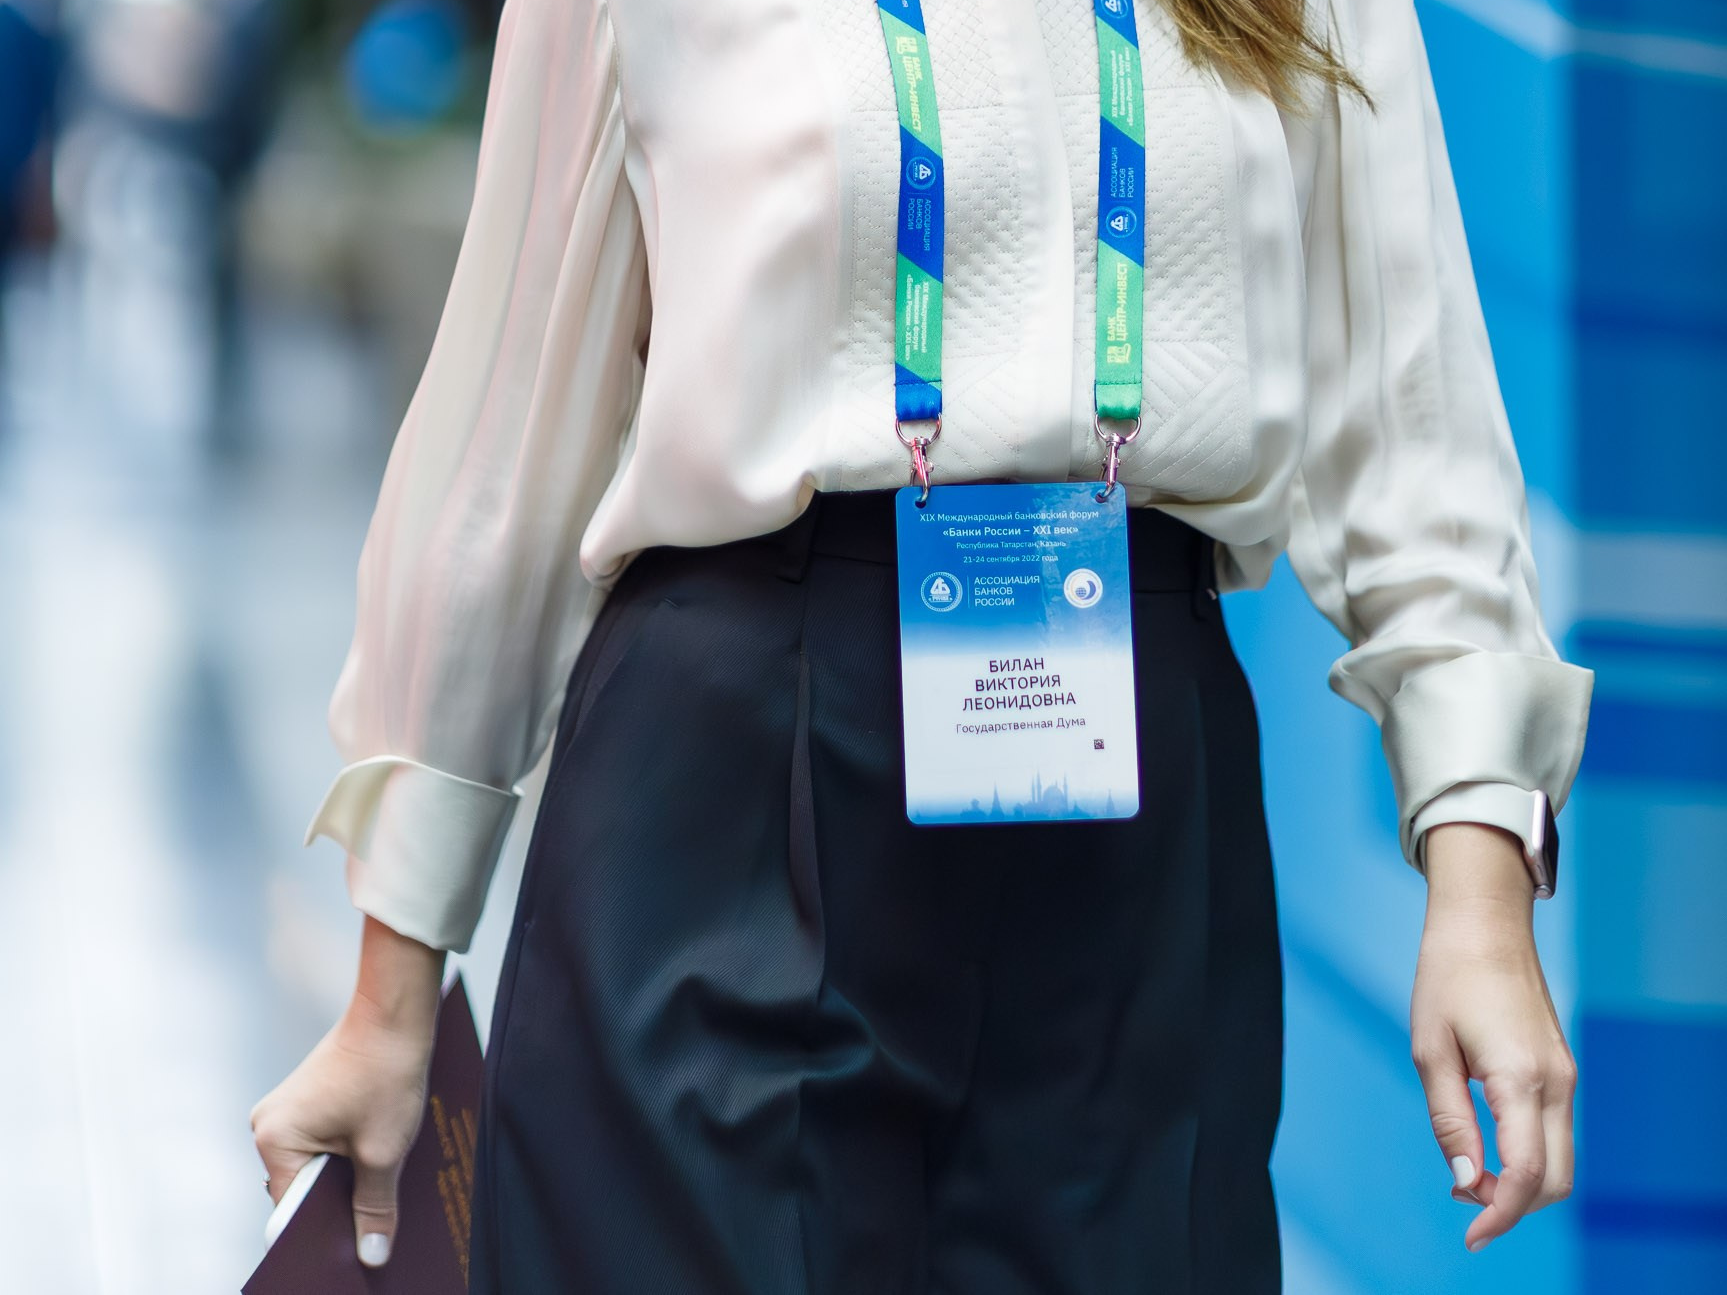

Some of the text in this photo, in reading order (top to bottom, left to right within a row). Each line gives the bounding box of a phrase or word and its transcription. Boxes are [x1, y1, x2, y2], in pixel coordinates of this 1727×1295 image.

[912, 56, 923, 80] БАНК
[902, 56, 922, 132] ЦЕНТР-ИНВЕСТ
[915, 199, 924, 230] БАНКОВ
[923, 199, 932, 251] АССОЦИАЦИЯ
[1116, 263, 1128, 341] ЦЕНТР-ИНВЕСТ
[1107, 316, 1115, 341] БАНК
[920, 509, 1099, 523] XIX Международный банковский форум
[943, 527, 981, 537] «Банки
[984, 526, 1021, 536] России
[1032, 525, 1051, 535] XXI
[1053, 525, 1079, 534] век»
[956, 539, 1067, 550] Республика Татарстан, Казань
[963, 555, 985, 563] 21-24
[986, 554, 1020, 563] сентября
[1021, 554, 1040, 562] 2022
[974, 575, 1040, 585] АССОЦИАЦИЯ
[974, 587, 1013, 596] БАНКОВ
[974, 598, 1015, 607] РОССИИ
[989, 657, 1045, 673] БИЛАН
[975, 674, 1061, 692] ВИКТОРИЯ
[962, 692, 1077, 711] ЛЕОНИДОВНА
[956, 717, 1086, 734] Государственная Дума
